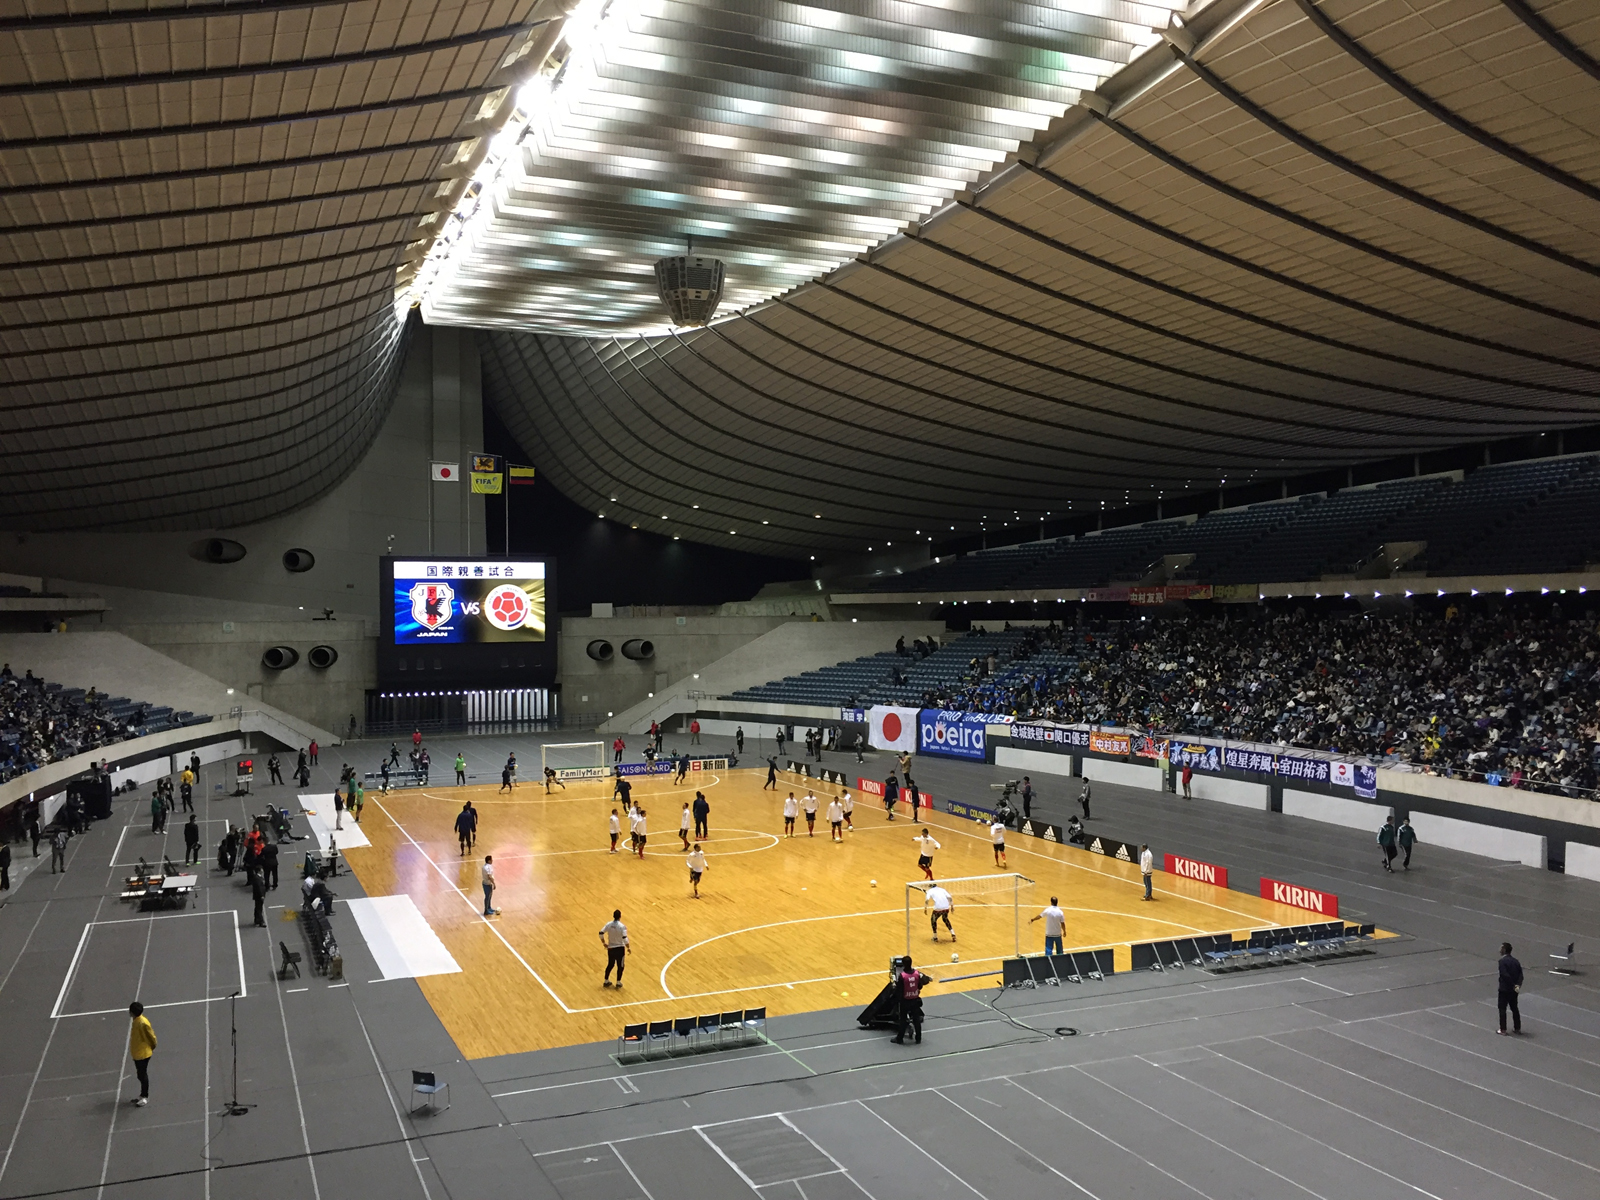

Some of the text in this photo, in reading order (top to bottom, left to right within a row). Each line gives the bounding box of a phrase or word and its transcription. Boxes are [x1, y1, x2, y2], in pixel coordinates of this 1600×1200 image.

[426, 566, 514, 577] 国際親善試合
[460, 601, 480, 615] VS
[922, 721, 984, 749] poeira
[1095, 738, 1128, 752] 中村友亮
[686, 760, 726, 771] 日新聞
[862, 779, 881, 795] KIRIN
[905, 790, 927, 807] KIIN
[953, 804, 993, 821] JAPAN COLOMBIA
[1089, 846, 1105, 855] adidas
[1115, 852, 1131, 862] adidas
[1174, 857, 1215, 884] KIRIN
[1273, 881, 1323, 912] KIRIN
